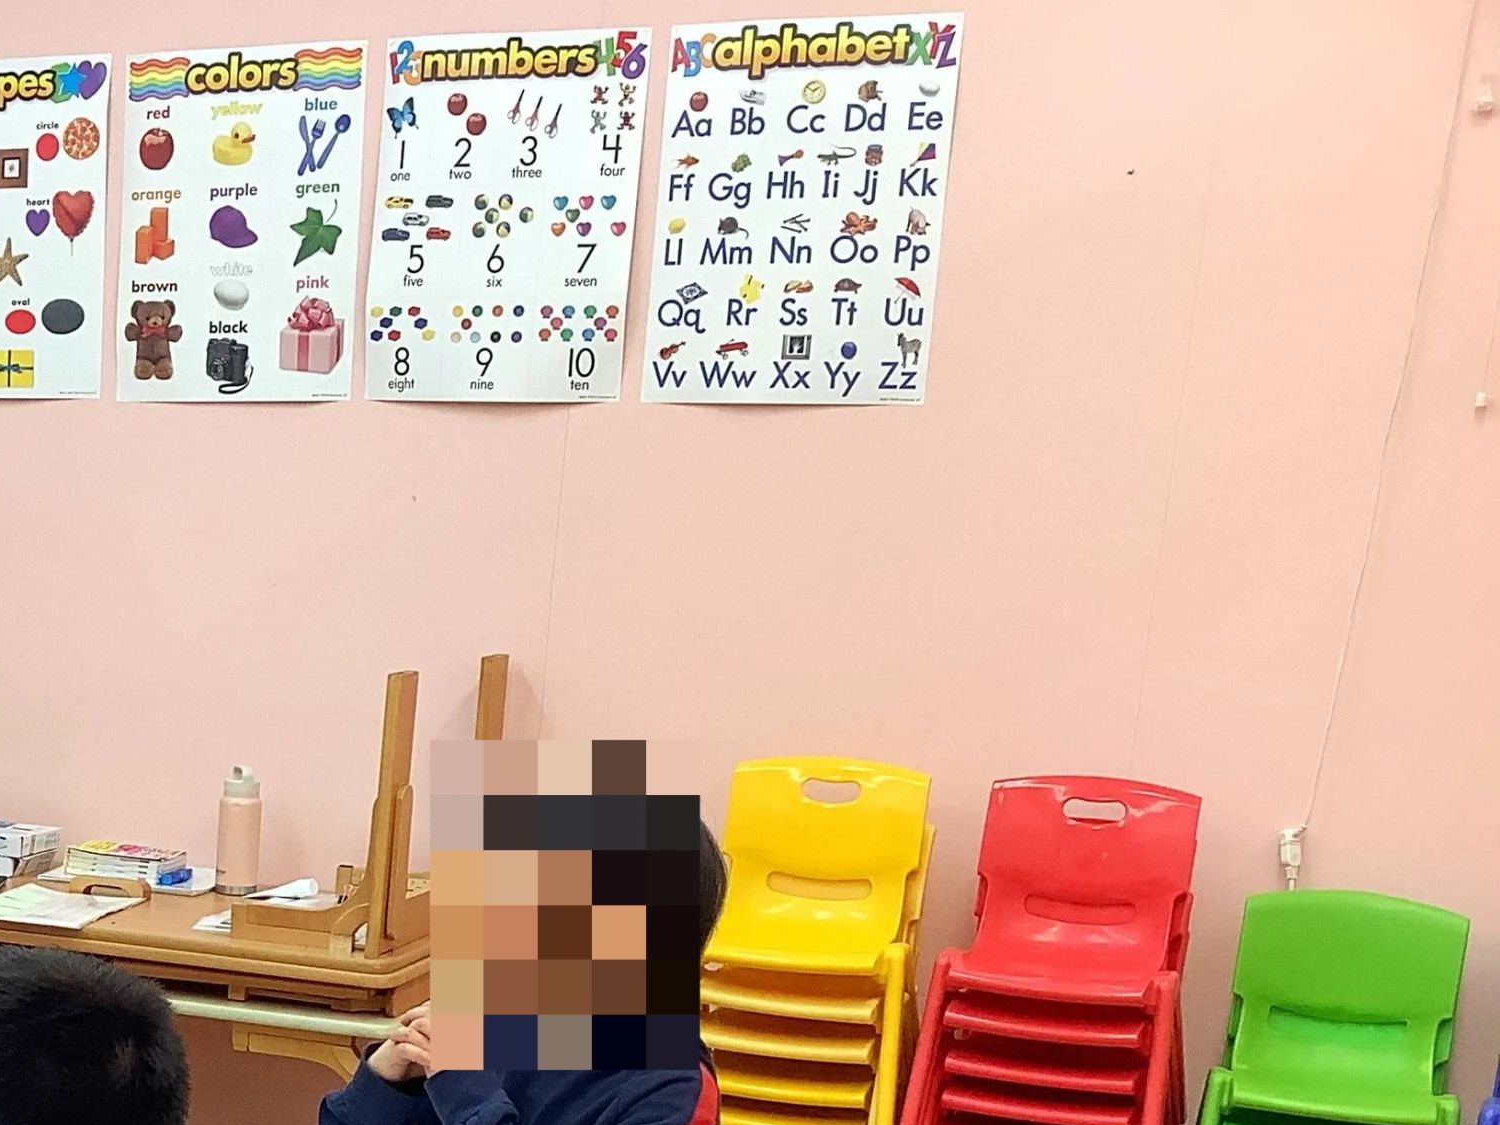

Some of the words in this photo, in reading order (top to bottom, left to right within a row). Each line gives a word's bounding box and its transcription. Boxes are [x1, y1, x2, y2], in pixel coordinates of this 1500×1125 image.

[420, 37, 599, 82] numbers
[711, 21, 911, 80] alphabet
[184, 52, 299, 95] colors
[146, 106, 171, 120] red
[210, 101, 263, 120] yellow
[304, 98, 338, 111] blue
[36, 121, 59, 130] circle
[671, 110, 713, 137] Aa
[729, 107, 765, 135] Bb
[786, 105, 826, 134] Cc
[844, 103, 886, 132] Dd
[907, 101, 943, 130] Ee
[399, 140, 406, 169] 1
[453, 137, 472, 168] 2
[519, 136, 538, 166] 3
[602, 134, 622, 164] 4
[390, 172, 411, 182] one
[449, 169, 472, 180] two
[512, 167, 543, 179] three
[599, 164, 626, 177] four
[131, 188, 182, 204] orange
[210, 183, 258, 201] purple
[295, 181, 340, 198] green
[668, 173, 695, 201] Ff
[708, 173, 752, 209] Gg
[766, 171, 805, 199] Hh
[821, 171, 839, 198] Ii
[854, 170, 879, 205] Jj
[899, 168, 939, 198] Kk
[26, 198, 51, 206] heart
[406, 245, 425, 274] 5
[486, 244, 505, 274] 6
[576, 244, 597, 273] 7
[699, 238, 753, 265] Mm
[770, 236, 812, 264] Nn
[830, 235, 879, 264] Oo
[894, 235, 930, 271] Pp
[210, 261, 253, 277] white
[131, 280, 178, 293] brown
[296, 275, 330, 293] pink
[403, 275, 423, 287] five
[486, 276, 503, 288] six
[564, 277, 597, 287] seven
[11, 298, 30, 306] oval
[657, 300, 706, 334] Qq
[726, 299, 757, 326] Rr
[779, 298, 808, 326] Ss
[831, 297, 857, 326] Tt
[884, 298, 924, 326] Uu
[209, 321, 248, 334] black
[394, 347, 410, 376] 8
[476, 347, 493, 377] 9
[567, 347, 596, 378] 10
[387, 378, 415, 392] eight
[470, 379, 494, 391] nine
[570, 379, 590, 391] ten
[652, 361, 688, 389] Vv
[699, 360, 756, 390] Ww
[769, 361, 811, 390] Xx
[824, 361, 861, 397] Yy
[878, 361, 917, 390] Zz
